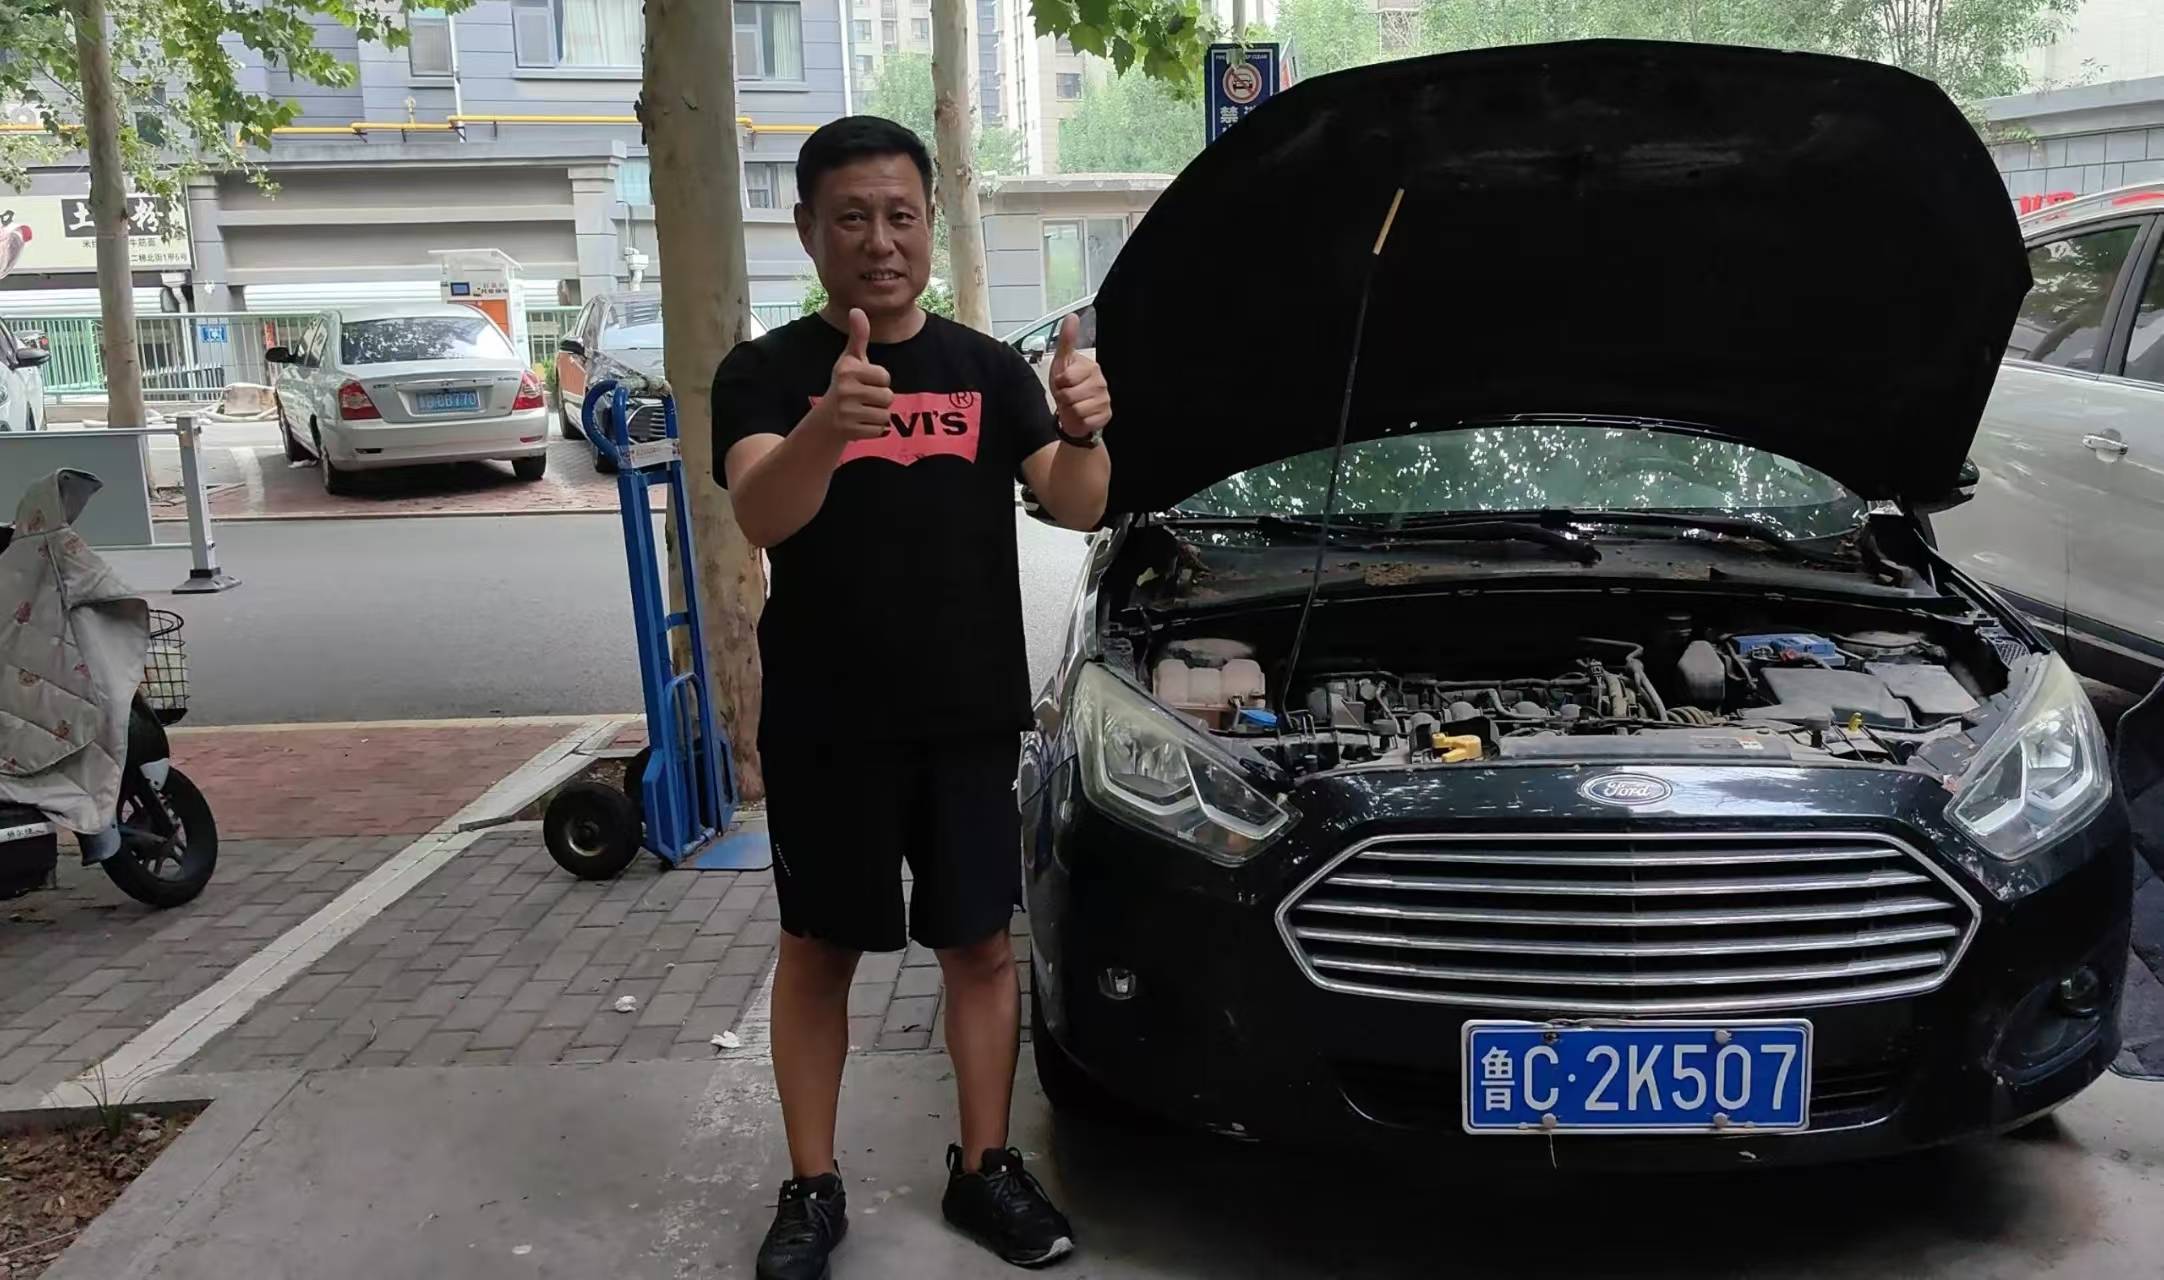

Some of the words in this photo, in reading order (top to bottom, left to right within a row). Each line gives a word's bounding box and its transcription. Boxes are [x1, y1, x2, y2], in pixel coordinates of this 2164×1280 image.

[69, 198, 163, 233] 土粉
[1603, 781, 1650, 797] Ford
[1481, 1044, 1797, 1111] 鲁C·2K507
